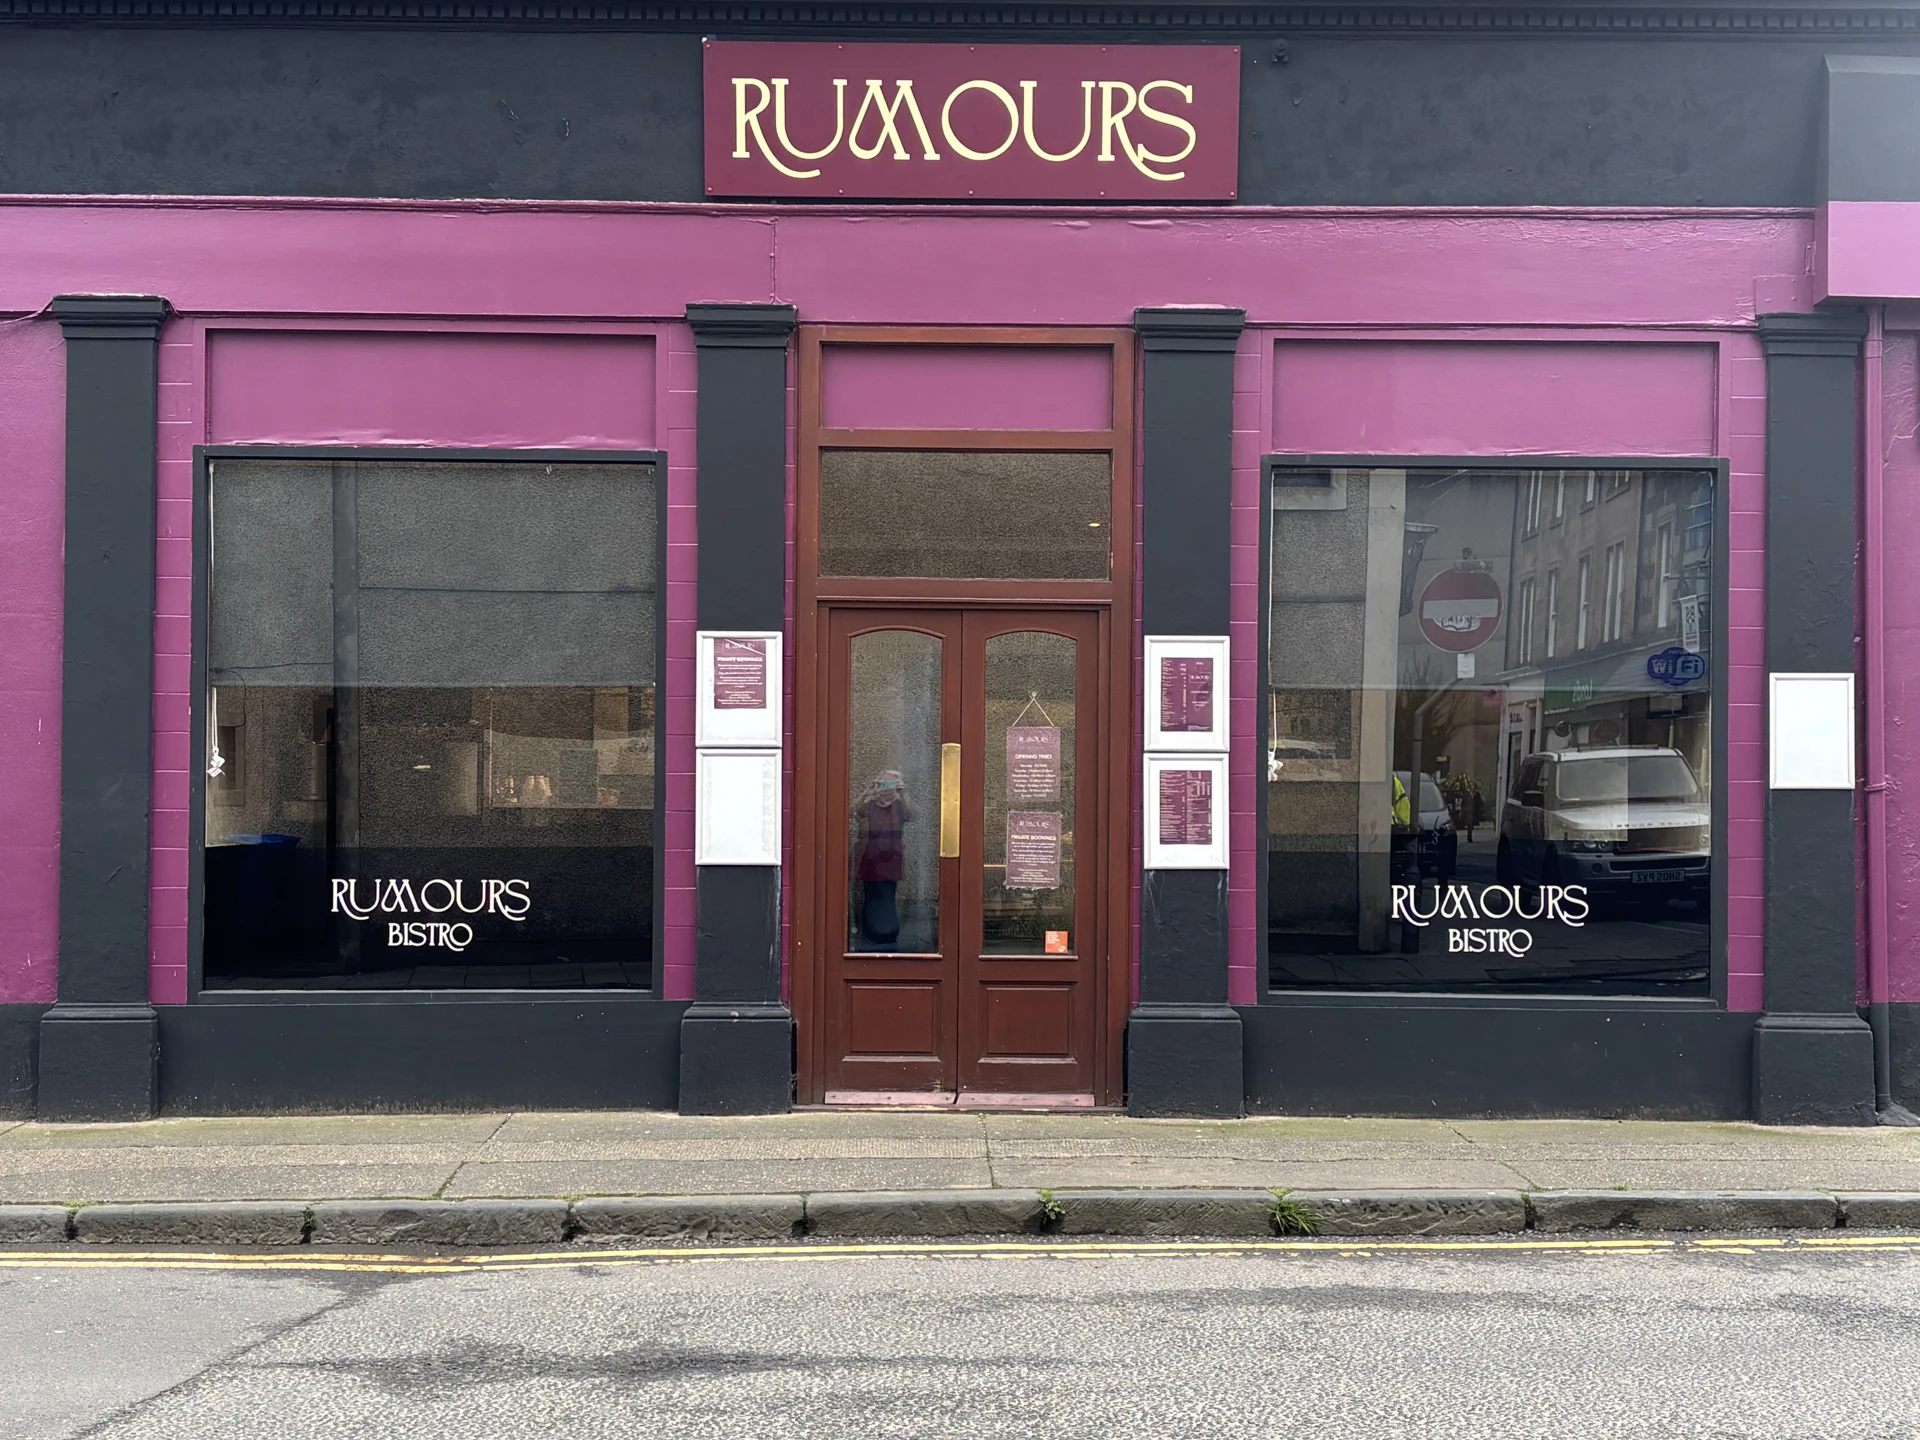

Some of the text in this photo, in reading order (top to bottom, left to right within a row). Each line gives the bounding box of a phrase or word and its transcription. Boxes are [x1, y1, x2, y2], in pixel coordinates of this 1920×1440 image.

[731, 77, 1197, 182] RUMOURS
[330, 878, 531, 922] RUMOURS
[1391, 884, 1589, 927] RUMOURS
[387, 922, 473, 952] BISTRO
[1448, 928, 1533, 958] BISTRO
